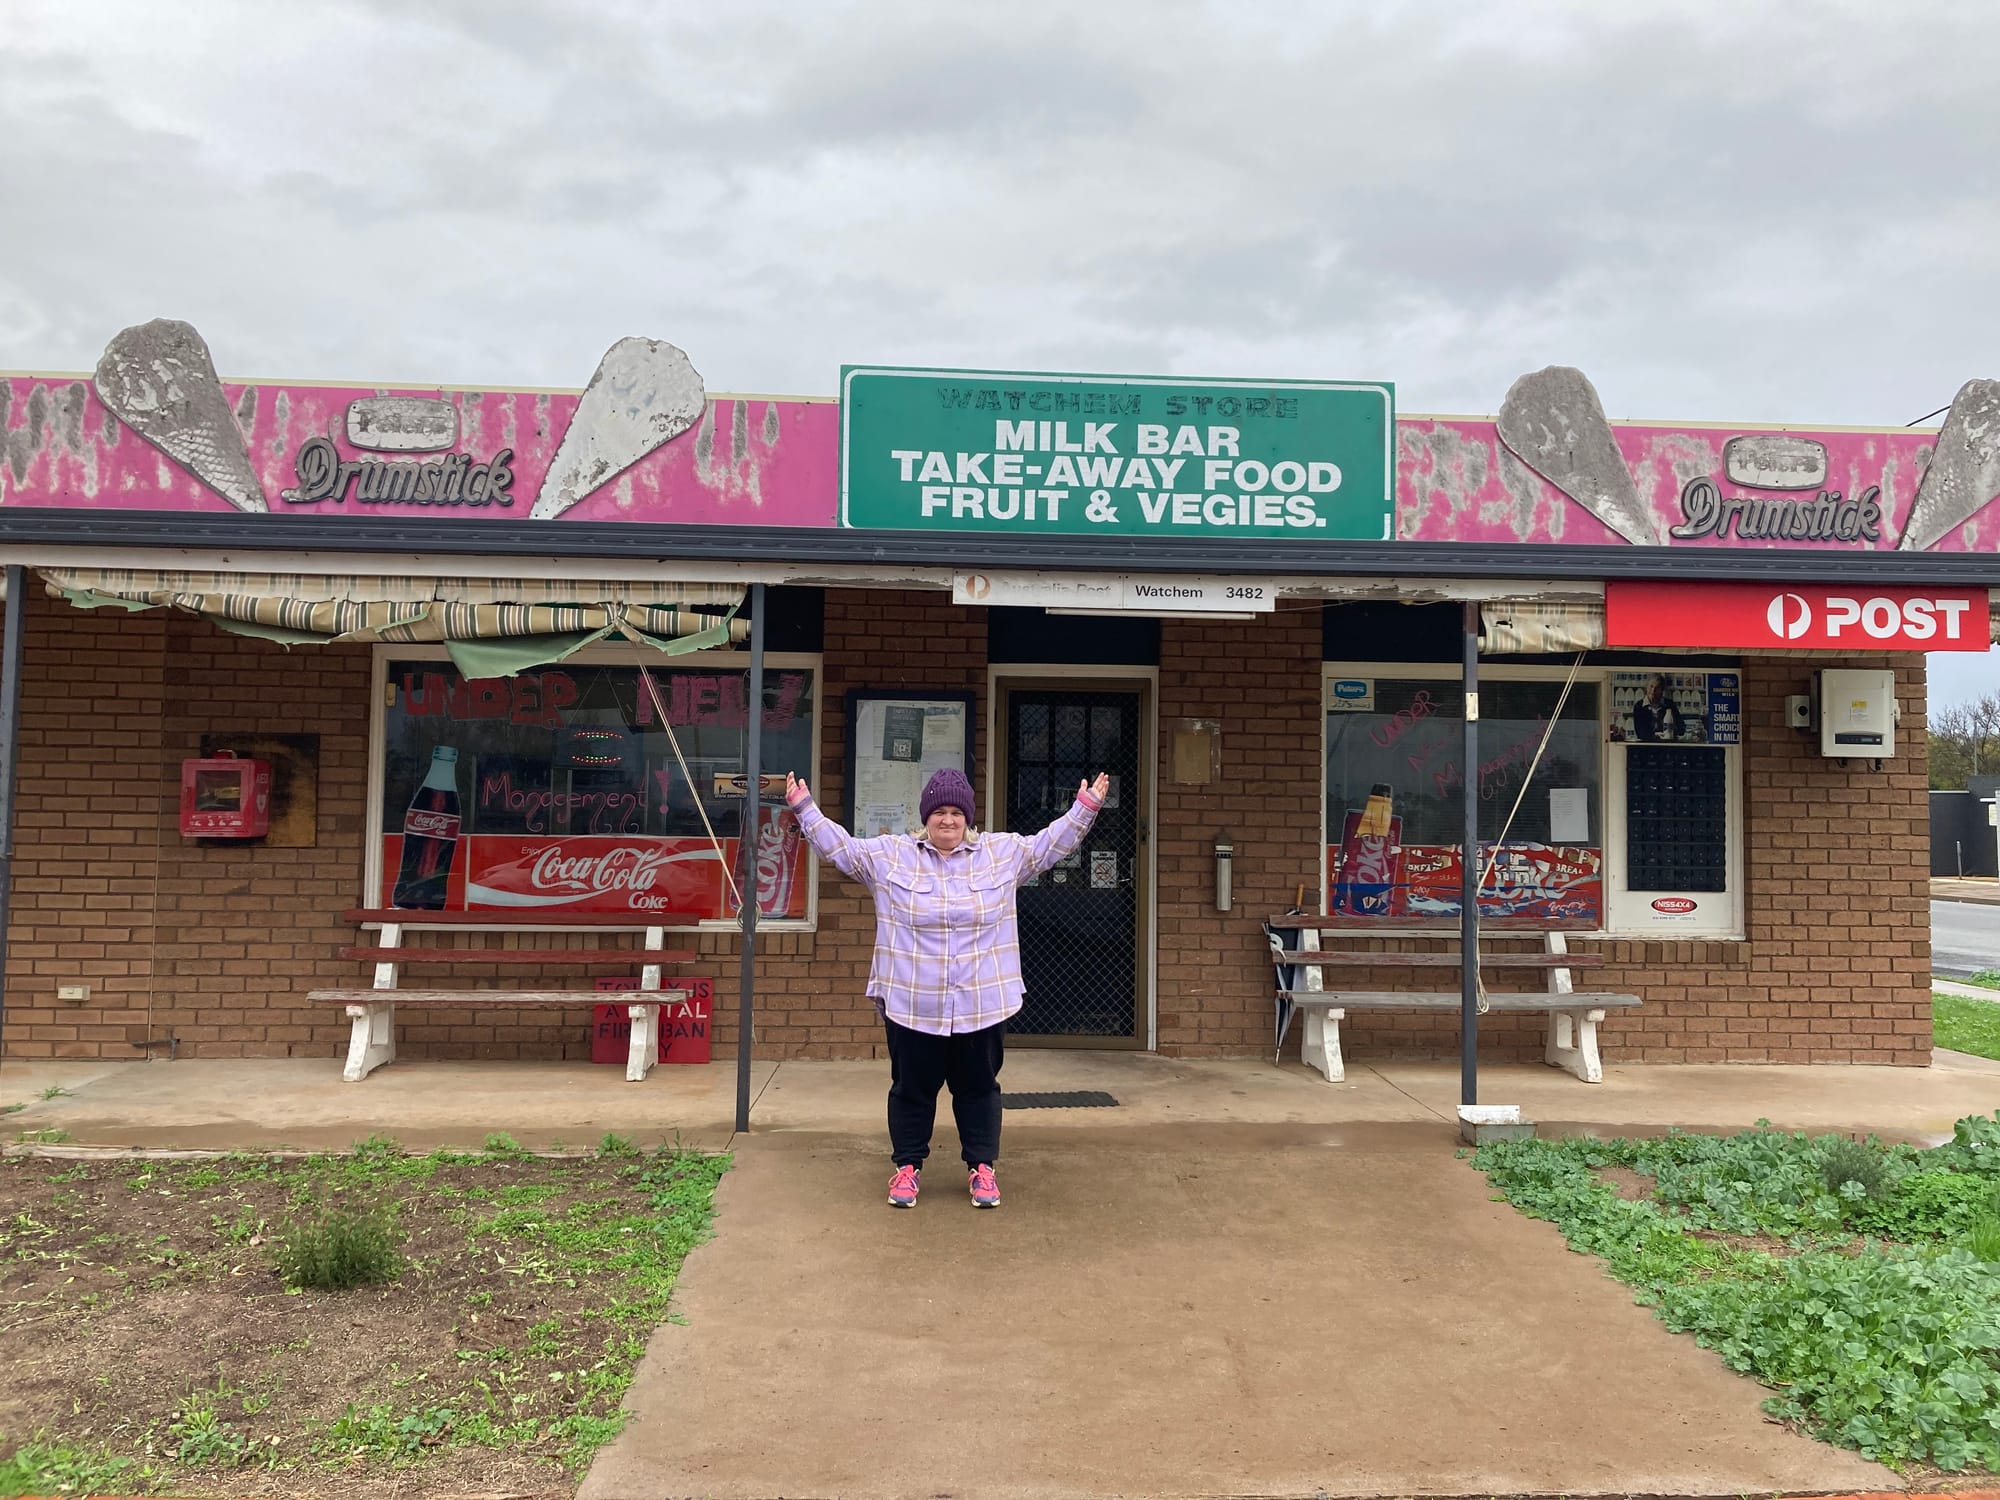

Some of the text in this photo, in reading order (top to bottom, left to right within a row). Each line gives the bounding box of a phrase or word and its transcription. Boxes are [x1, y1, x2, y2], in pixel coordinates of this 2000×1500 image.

[937, 388, 1299, 418] WATCHEM STORE
[996, 419, 1240, 456] MILK BAR
[281, 437, 514, 506] Drumstick
[891, 450, 1342, 493] TAKE-AWAY FOOD
[921, 486, 1327, 528] FRUIT & VEGIES.
[1670, 476, 1881, 541] Drumstick
[1135, 584, 1263, 599] Watchem 3482
[1826, 597, 1970, 640] POST
[404, 671, 579, 729] UNDER
[1713, 703, 1729, 712] THE
[1713, 733, 1721, 741] IN
[531, 846, 661, 891] Coca-Cola
[629, 891, 669, 909] Coke
[661, 1022, 704, 1038] BAN
